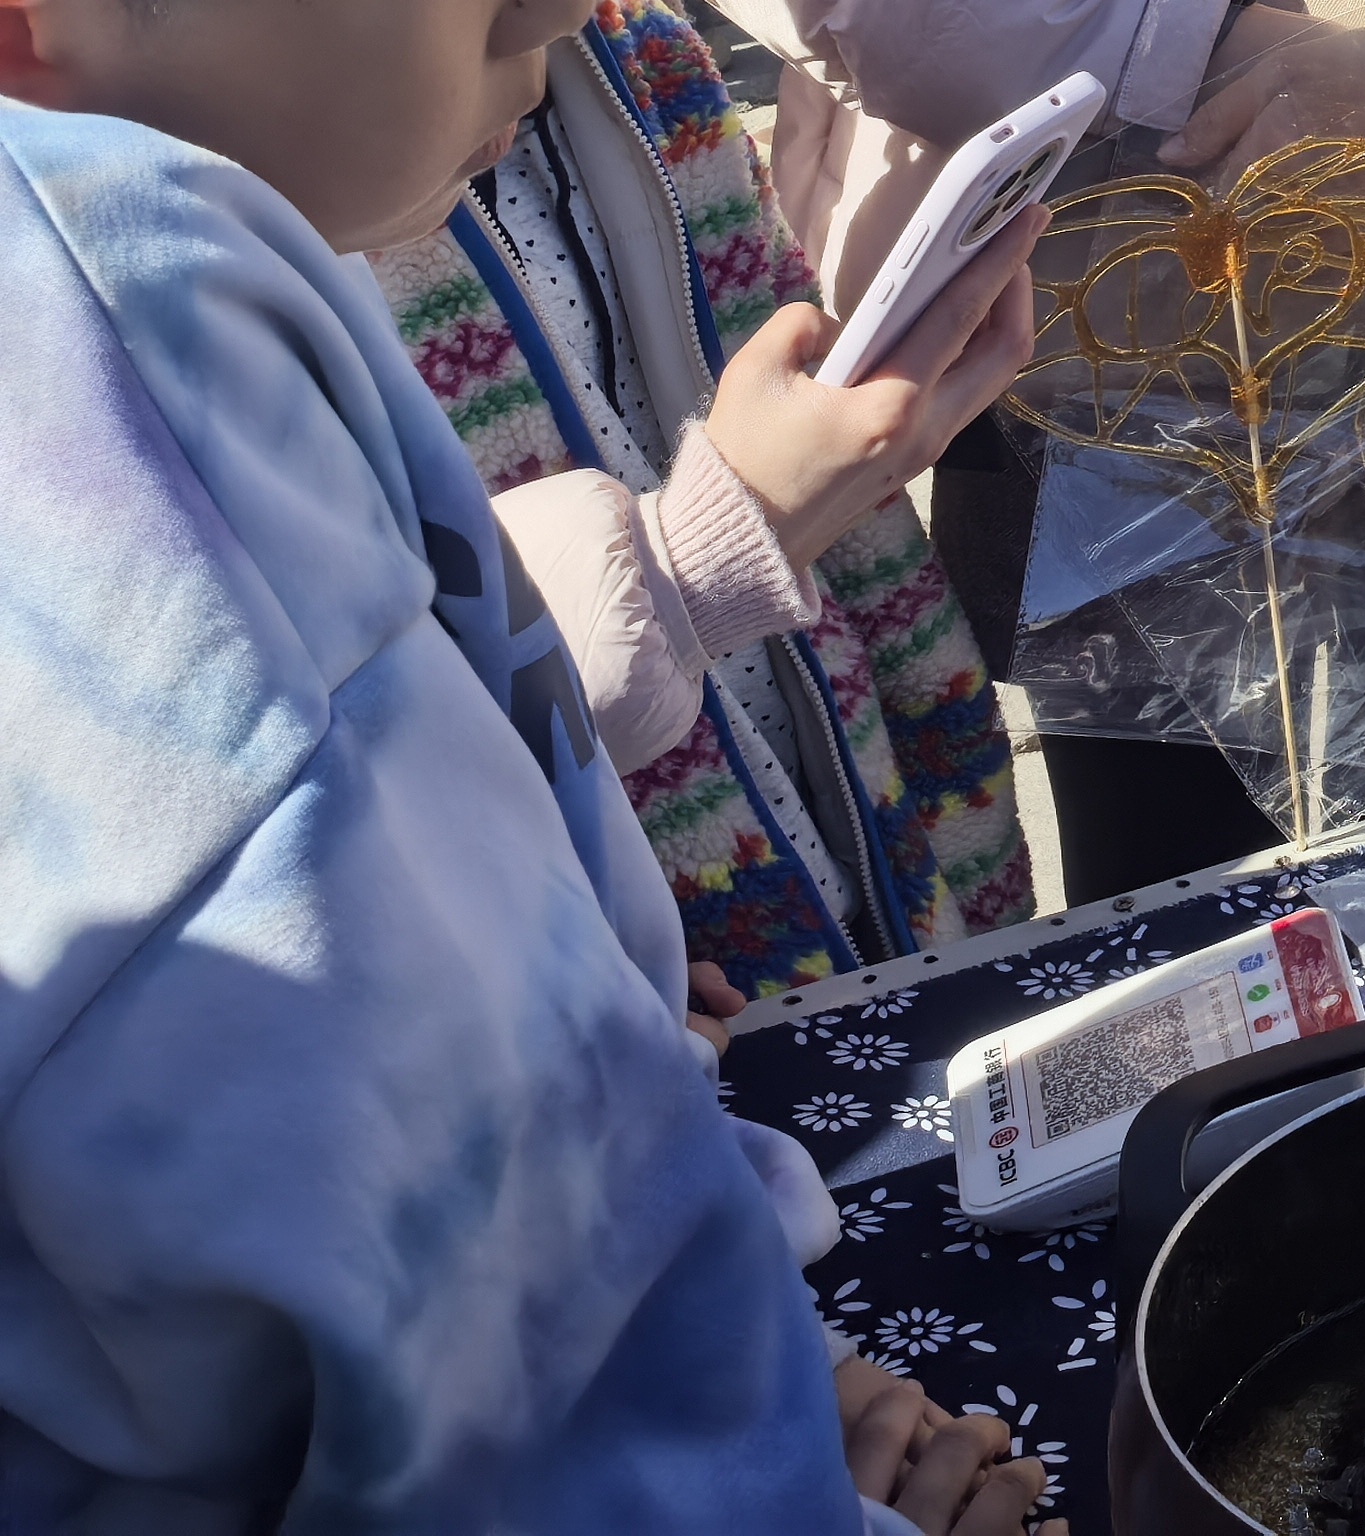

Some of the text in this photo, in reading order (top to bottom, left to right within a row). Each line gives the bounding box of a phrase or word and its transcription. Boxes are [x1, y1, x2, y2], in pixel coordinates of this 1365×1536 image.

[983, 1046, 1011, 1124] 中国工商银行
[997, 1148, 1018, 1187] ICBC
